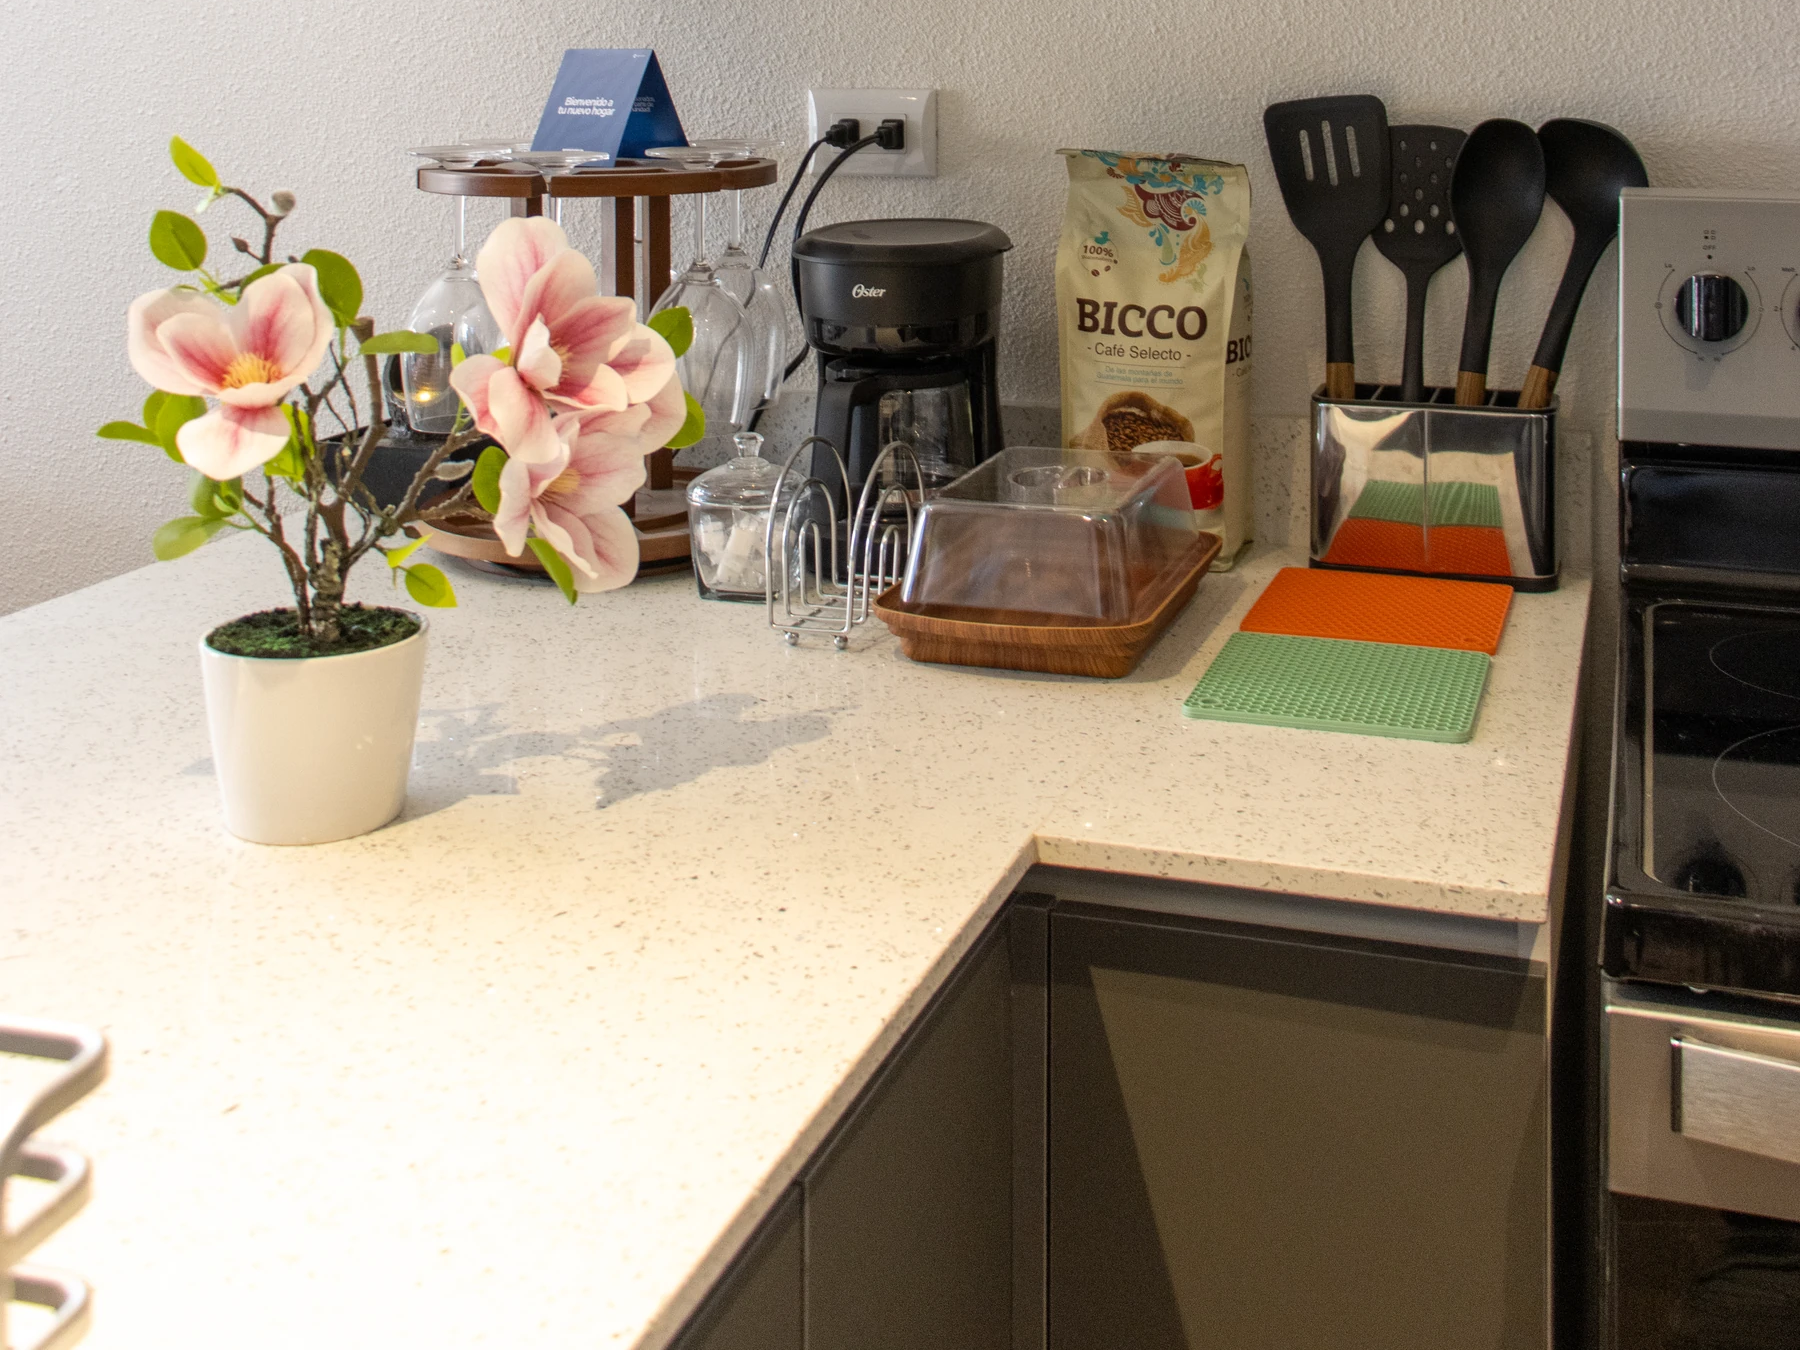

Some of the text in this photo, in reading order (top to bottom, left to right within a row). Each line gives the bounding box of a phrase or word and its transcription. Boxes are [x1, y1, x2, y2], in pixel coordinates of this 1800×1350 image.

[564, 96, 608, 106] Bienvenido
[557, 106, 566, 114] tu
[591, 106, 616, 117] hogar
[1083, 244, 1114, 258] 100%
[852, 283, 886, 298] Oster
[1076, 298, 1208, 340] BICCO
[1095, 342, 1125, 358] Café
[1129, 345, 1182, 360] Selecto
[1105, 365, 1115, 373] De
